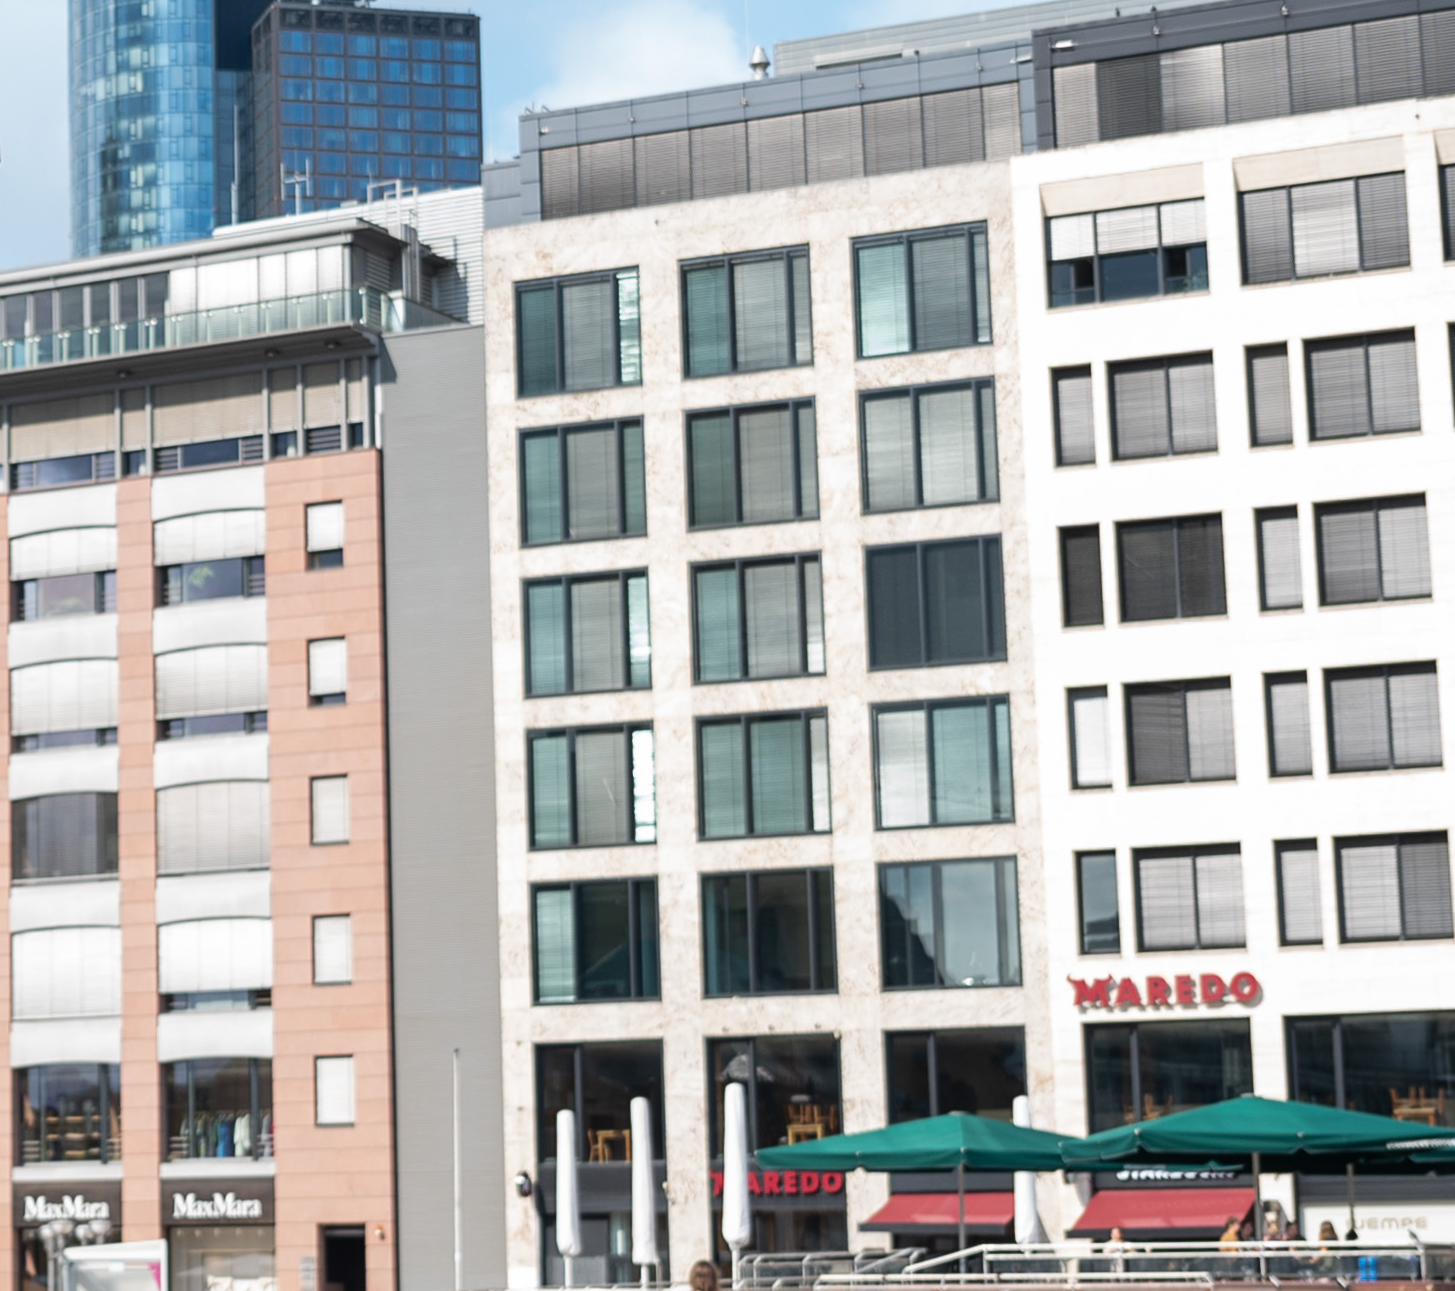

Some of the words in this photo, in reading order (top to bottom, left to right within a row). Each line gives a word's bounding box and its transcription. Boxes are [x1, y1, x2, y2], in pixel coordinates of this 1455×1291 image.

[1066, 971, 1259, 1007] MAREDO
[23, 1195, 110, 1221] MaxMara
[172, 1192, 262, 1220] MaxMara
